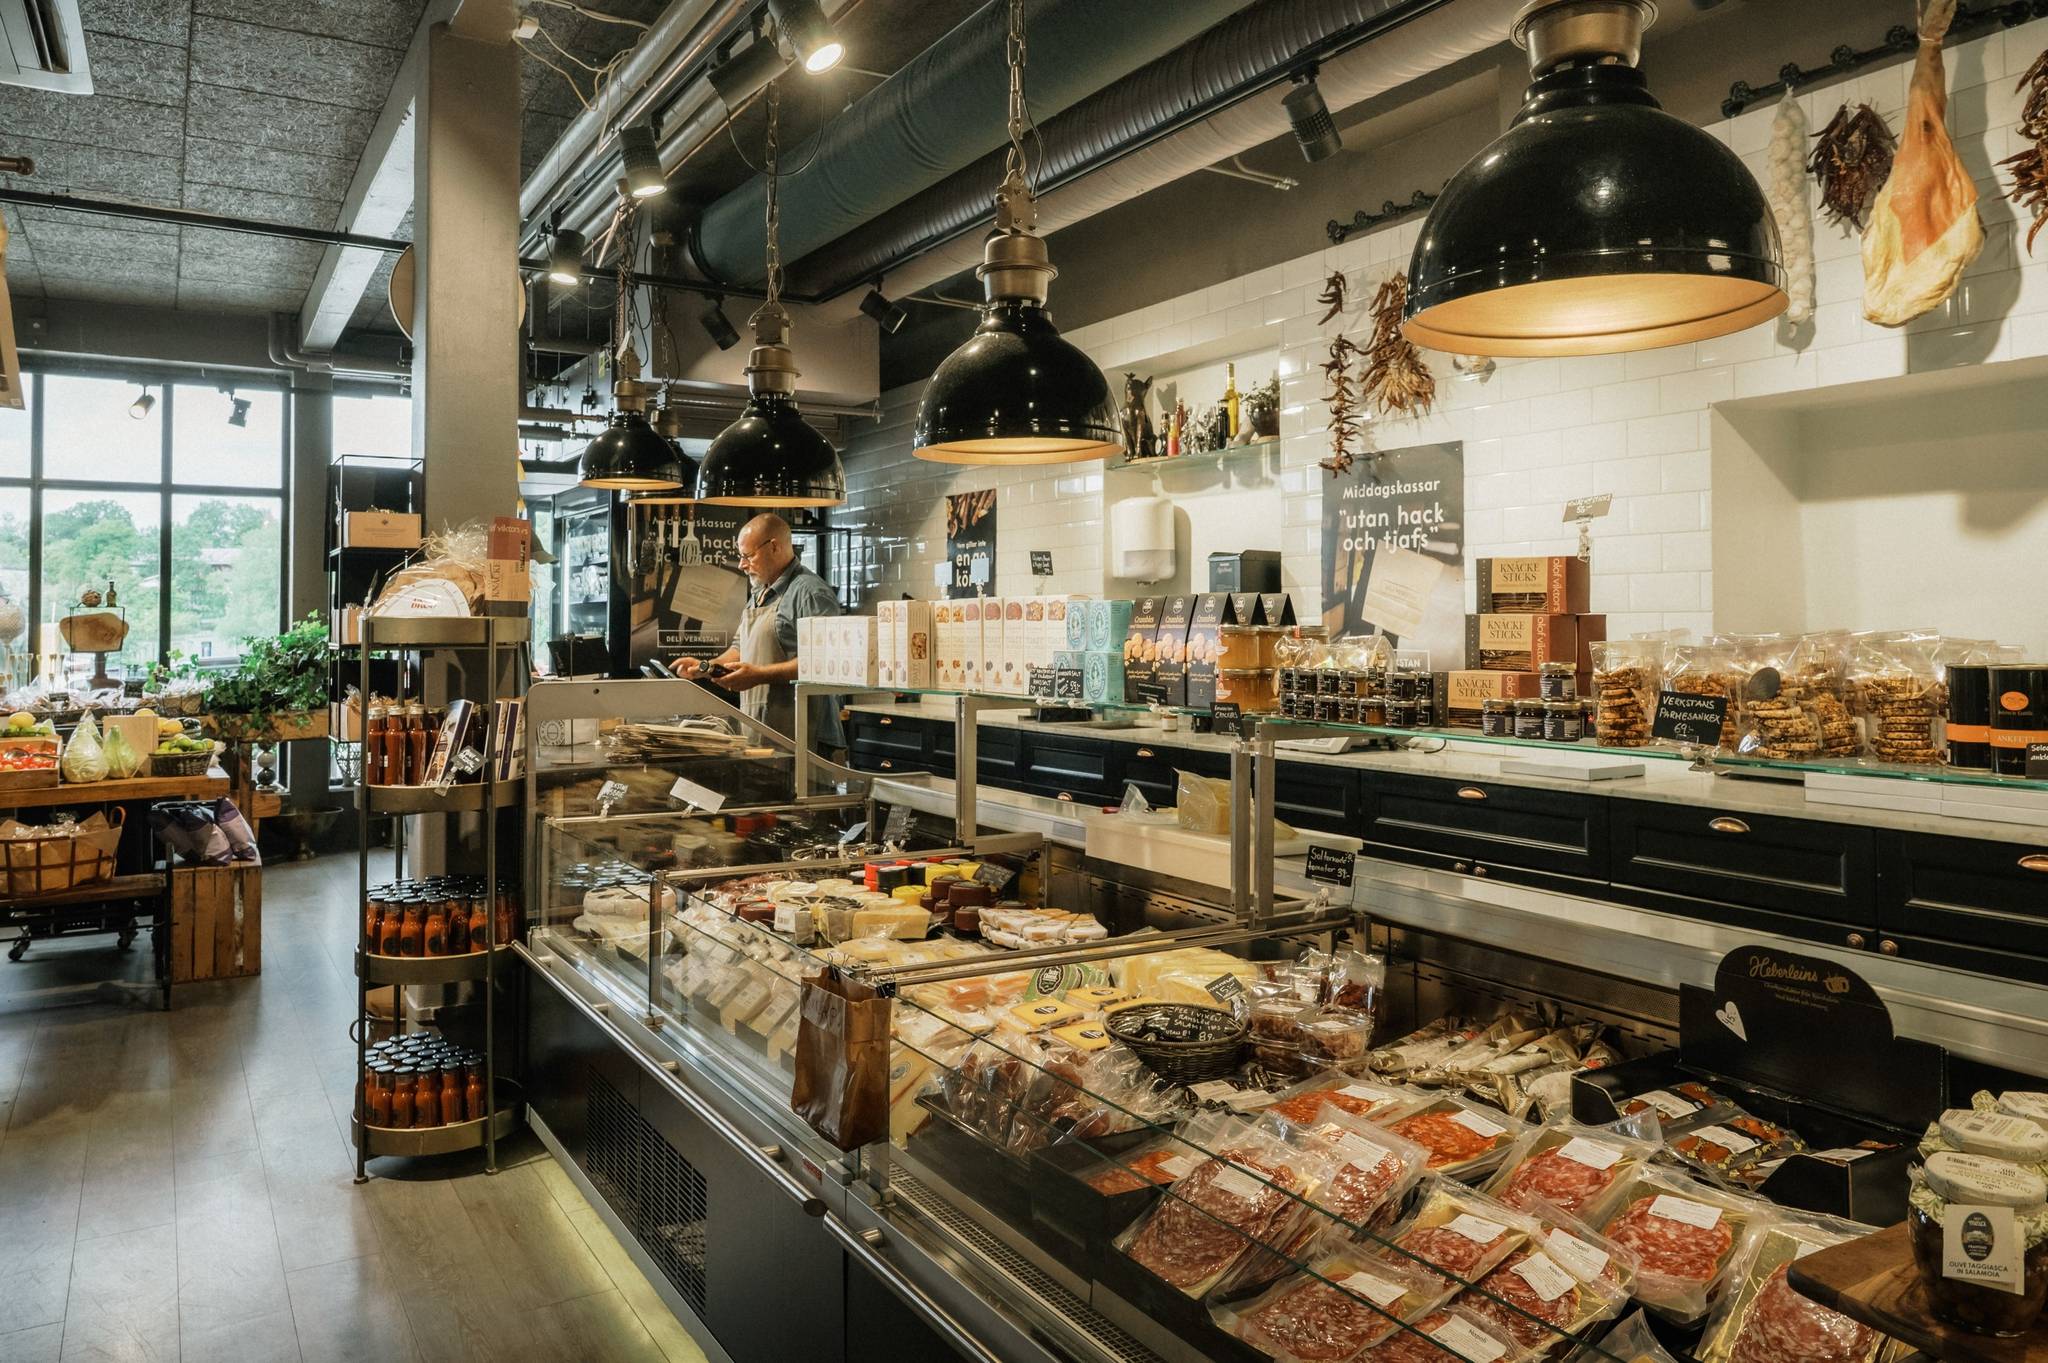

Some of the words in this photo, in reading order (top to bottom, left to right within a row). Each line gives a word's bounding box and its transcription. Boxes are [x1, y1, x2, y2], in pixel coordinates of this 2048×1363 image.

[1343, 479, 1440, 499] Middagskassar
[1397, 502, 1444, 526] hack
[1343, 531, 1375, 551] och
[956, 553, 970, 567] en
[1500, 560, 1540, 573] KNÄCKE
[1552, 558, 1563, 580] olof
[1503, 572, 1538, 582] STICKS
[1552, 581, 1563, 612] viktors
[1487, 617, 1526, 631] KNÄCKE
[1537, 616, 1547, 636] olof
[666, 635, 682, 643] DELI
[684, 635, 720, 643] VERKSTAN
[1489, 630, 1523, 640] STICKS
[1456, 676, 1495, 689] KNÄCKE
[1458, 687, 1492, 698] STICKS
[1663, 695, 1715, 709] VERKSTANS
[1659, 707, 1721, 725] PARMESANKEX
[1749, 955, 1818, 983] Heberleins
[1571, 1240, 1590, 1253] Napoli
[1965, 1268, 2000, 1278] SALAMOIA
[1968, 1262, 2009, 1273] TAGGIASCA
